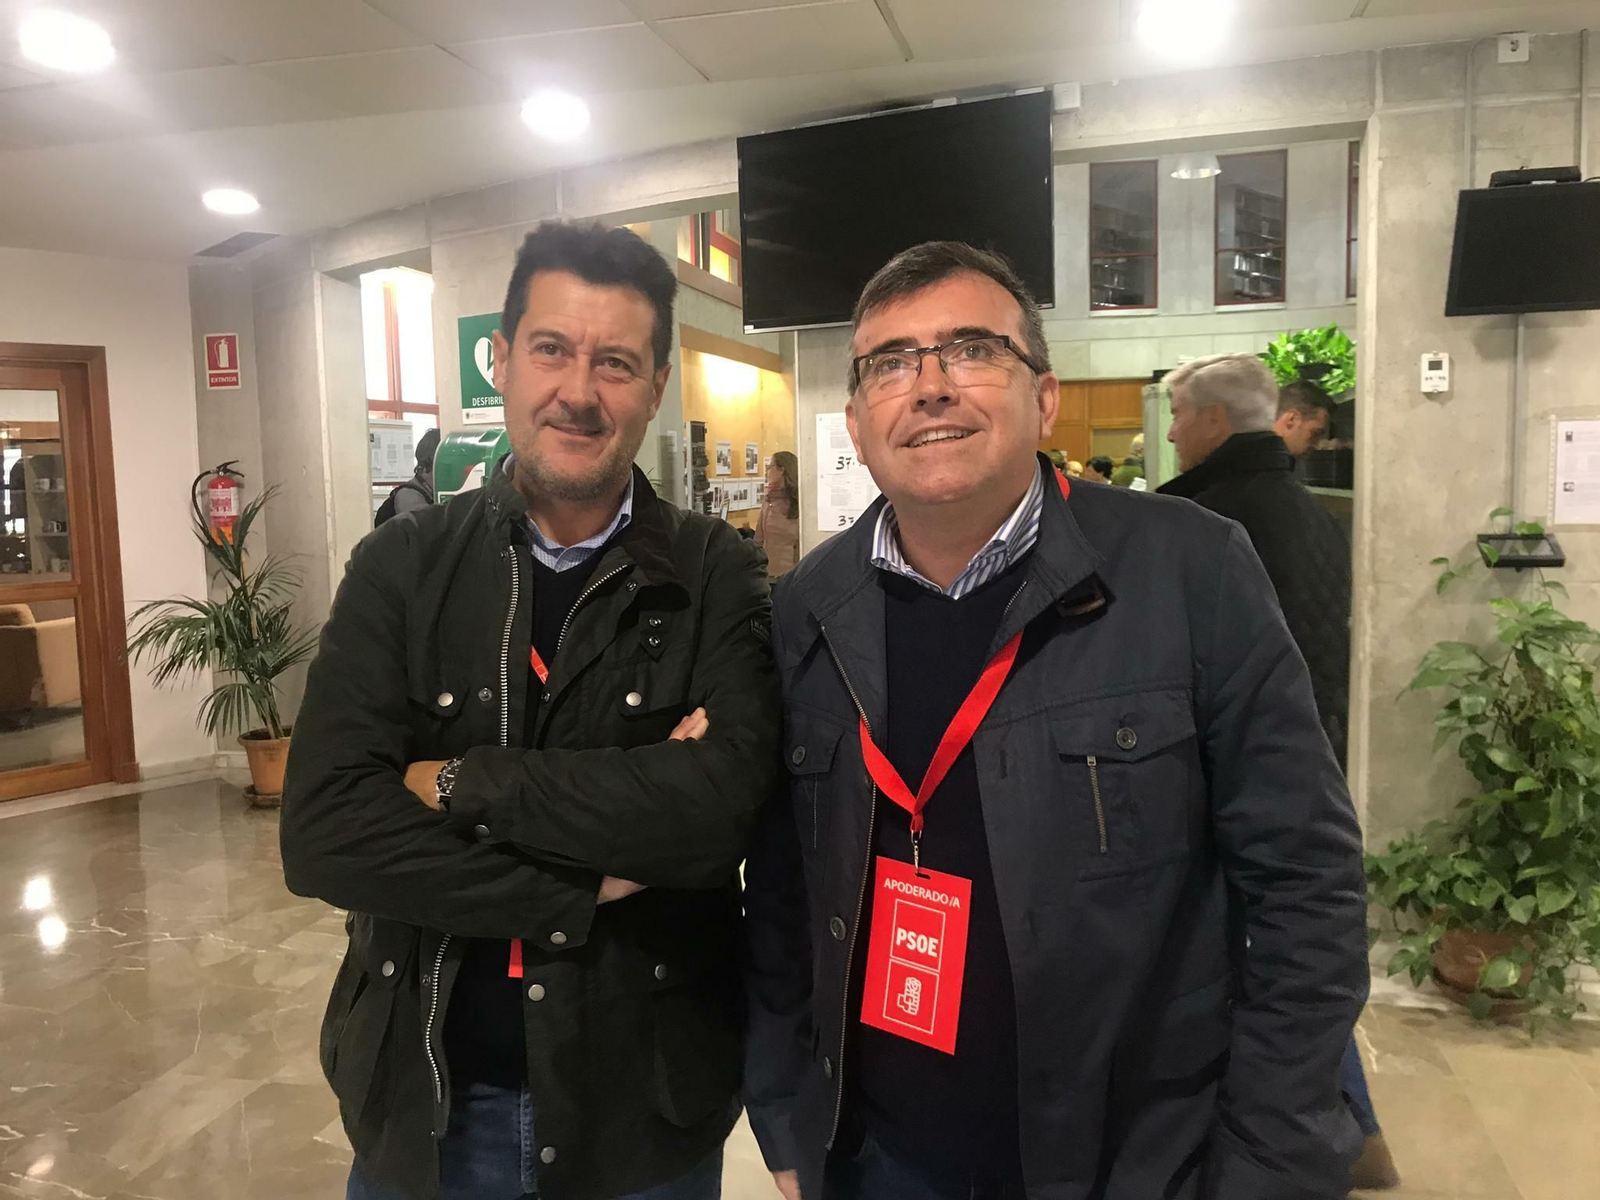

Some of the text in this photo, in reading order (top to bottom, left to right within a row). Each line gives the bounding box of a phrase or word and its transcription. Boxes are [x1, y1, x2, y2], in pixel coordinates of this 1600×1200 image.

[210, 376, 238, 384] EXTINTOR
[883, 877, 961, 909] APODERADO/A
[895, 927, 939, 958] PSOE
